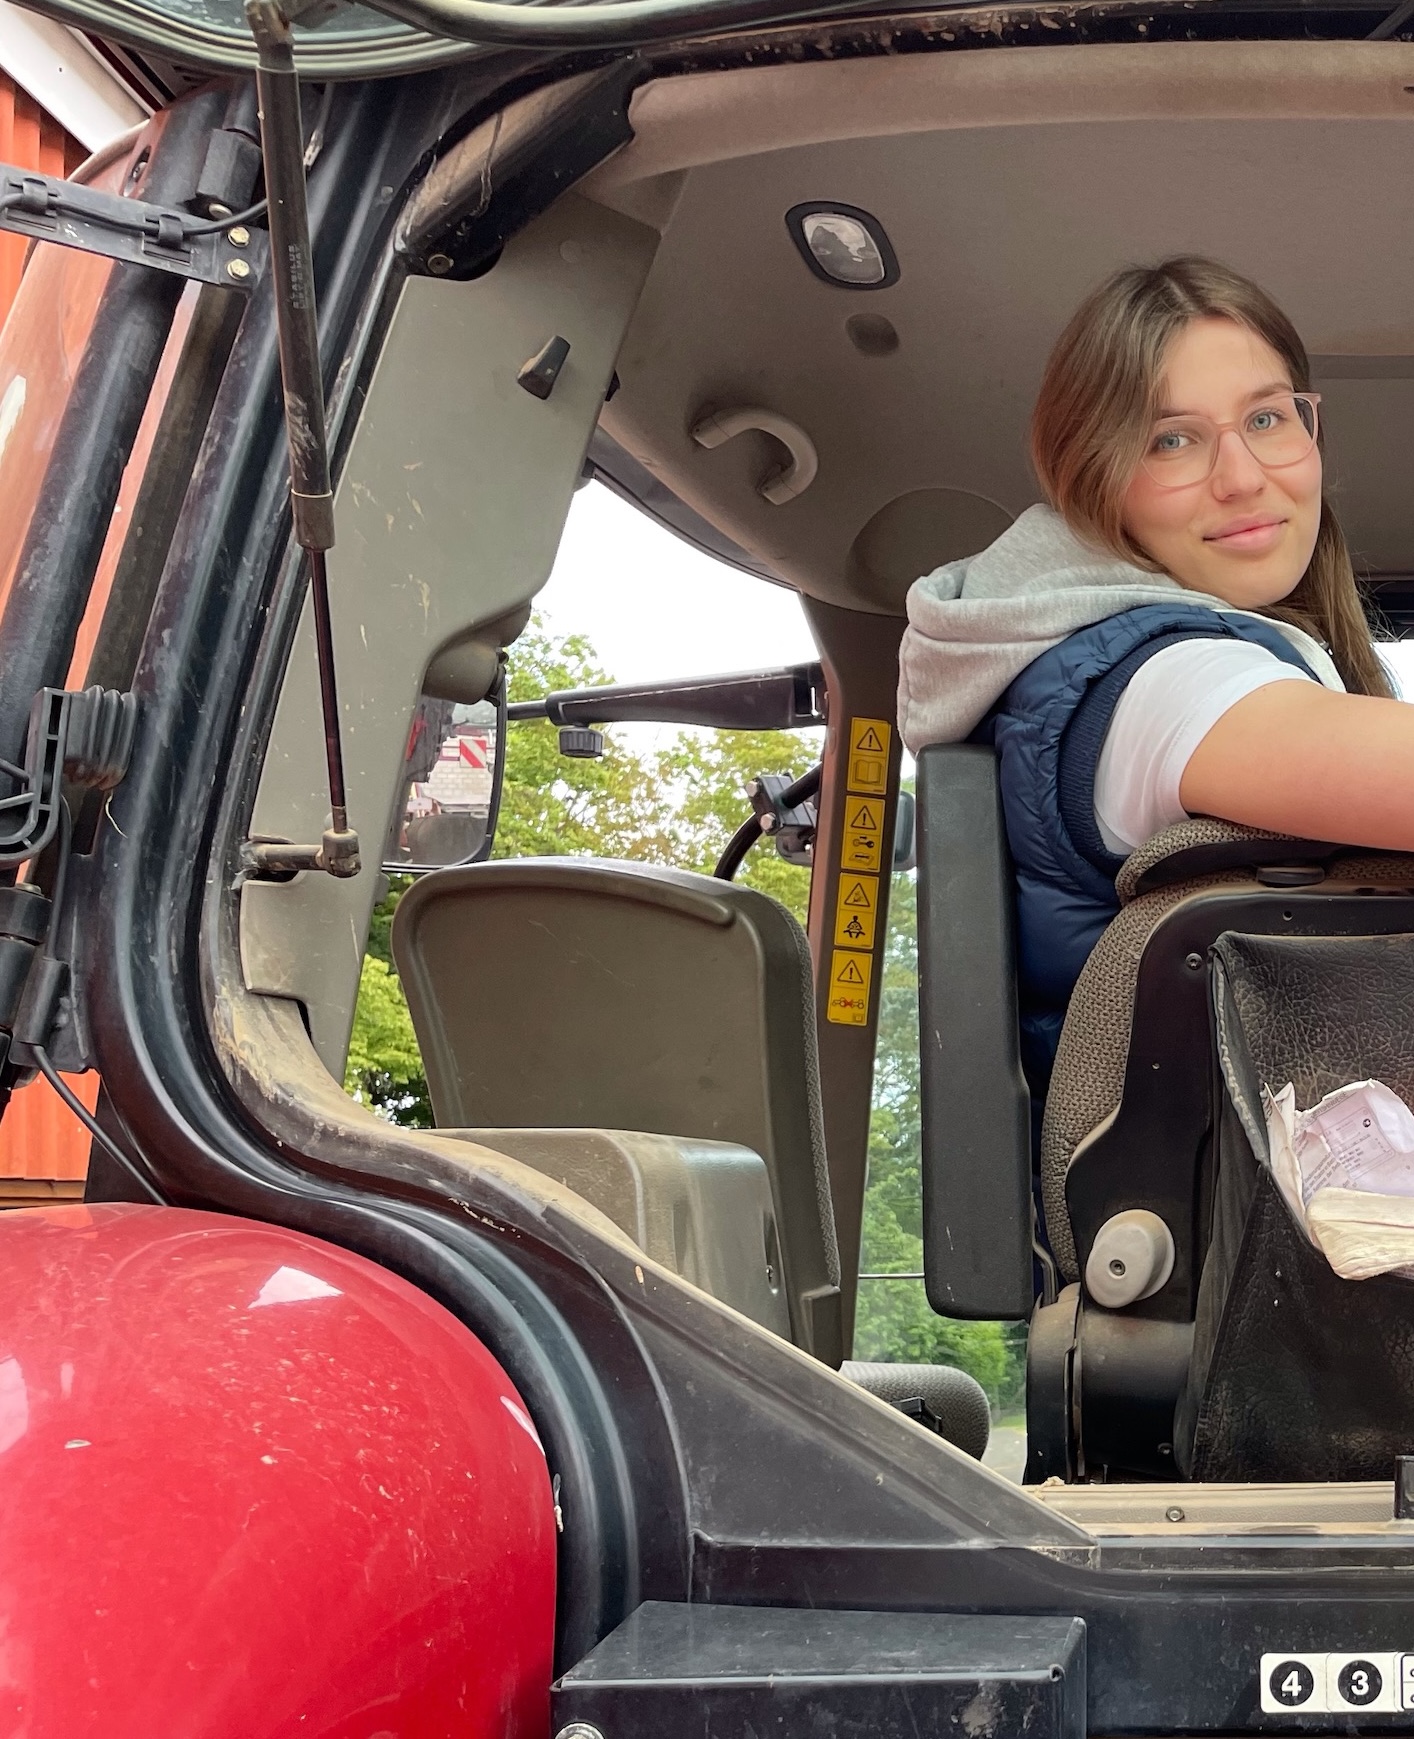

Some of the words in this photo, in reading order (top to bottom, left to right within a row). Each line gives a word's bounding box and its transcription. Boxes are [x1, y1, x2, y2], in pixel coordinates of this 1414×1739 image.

[288, 245, 299, 309] STABILUS
[1281, 1669, 1302, 1697] 4
[1350, 1670, 1370, 1696] 3
